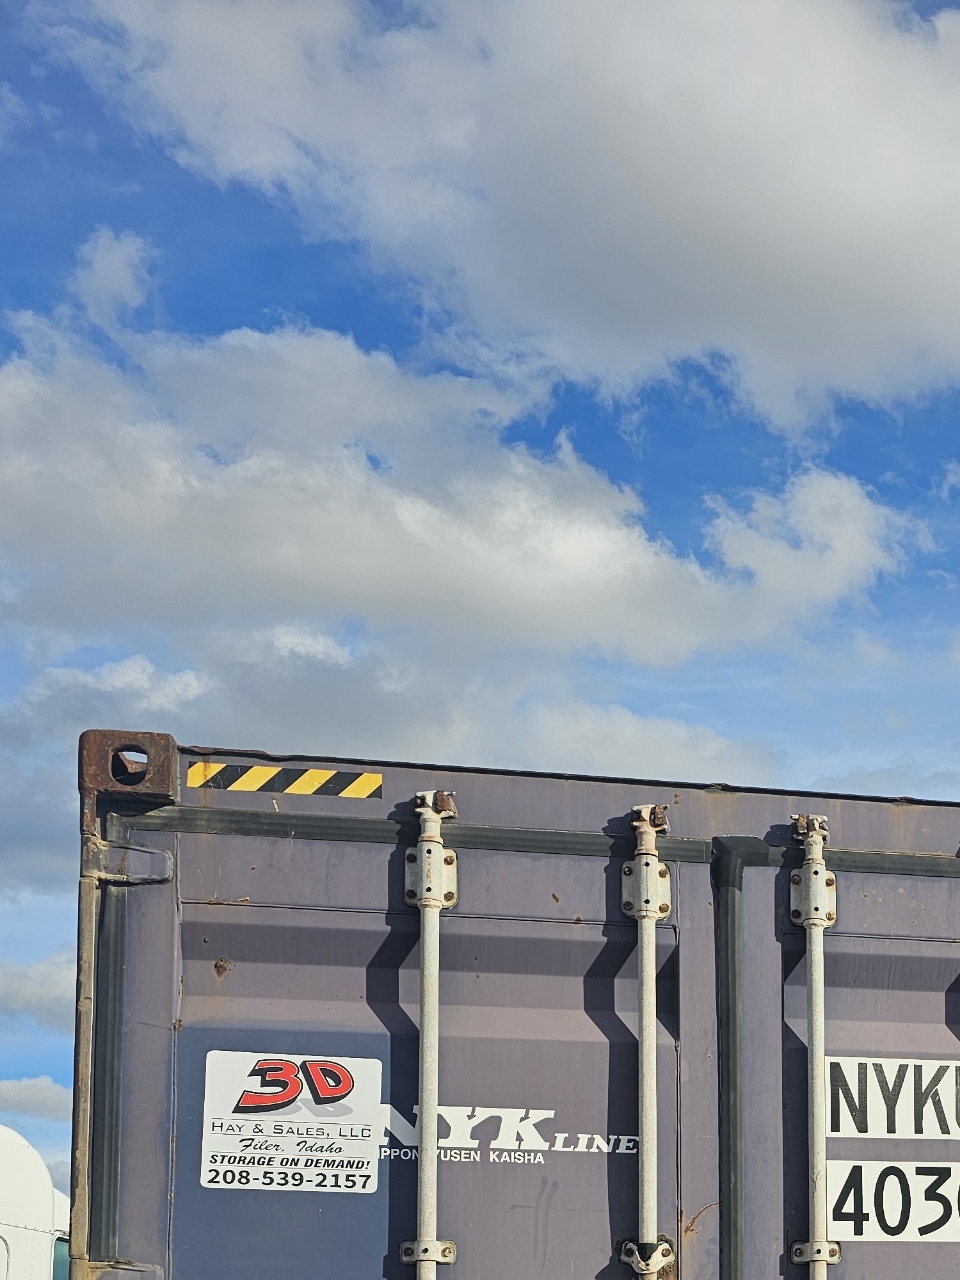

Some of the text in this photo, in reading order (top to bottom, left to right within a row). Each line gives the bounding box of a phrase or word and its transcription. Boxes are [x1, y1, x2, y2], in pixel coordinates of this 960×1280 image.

[232, 1059, 354, 1113] 3D
[253, 1124, 264, 1134] &
[339, 1127, 371, 1138] LLC
[378, 1103, 639, 1153] NYK LINE
[297, 1140, 344, 1154] Idaho
[209, 1154, 371, 1170] STORAGE ON DEMAND!
[489, 1150, 545, 1164] KAISHA
[207, 1168, 372, 1189] 208-539-2157
